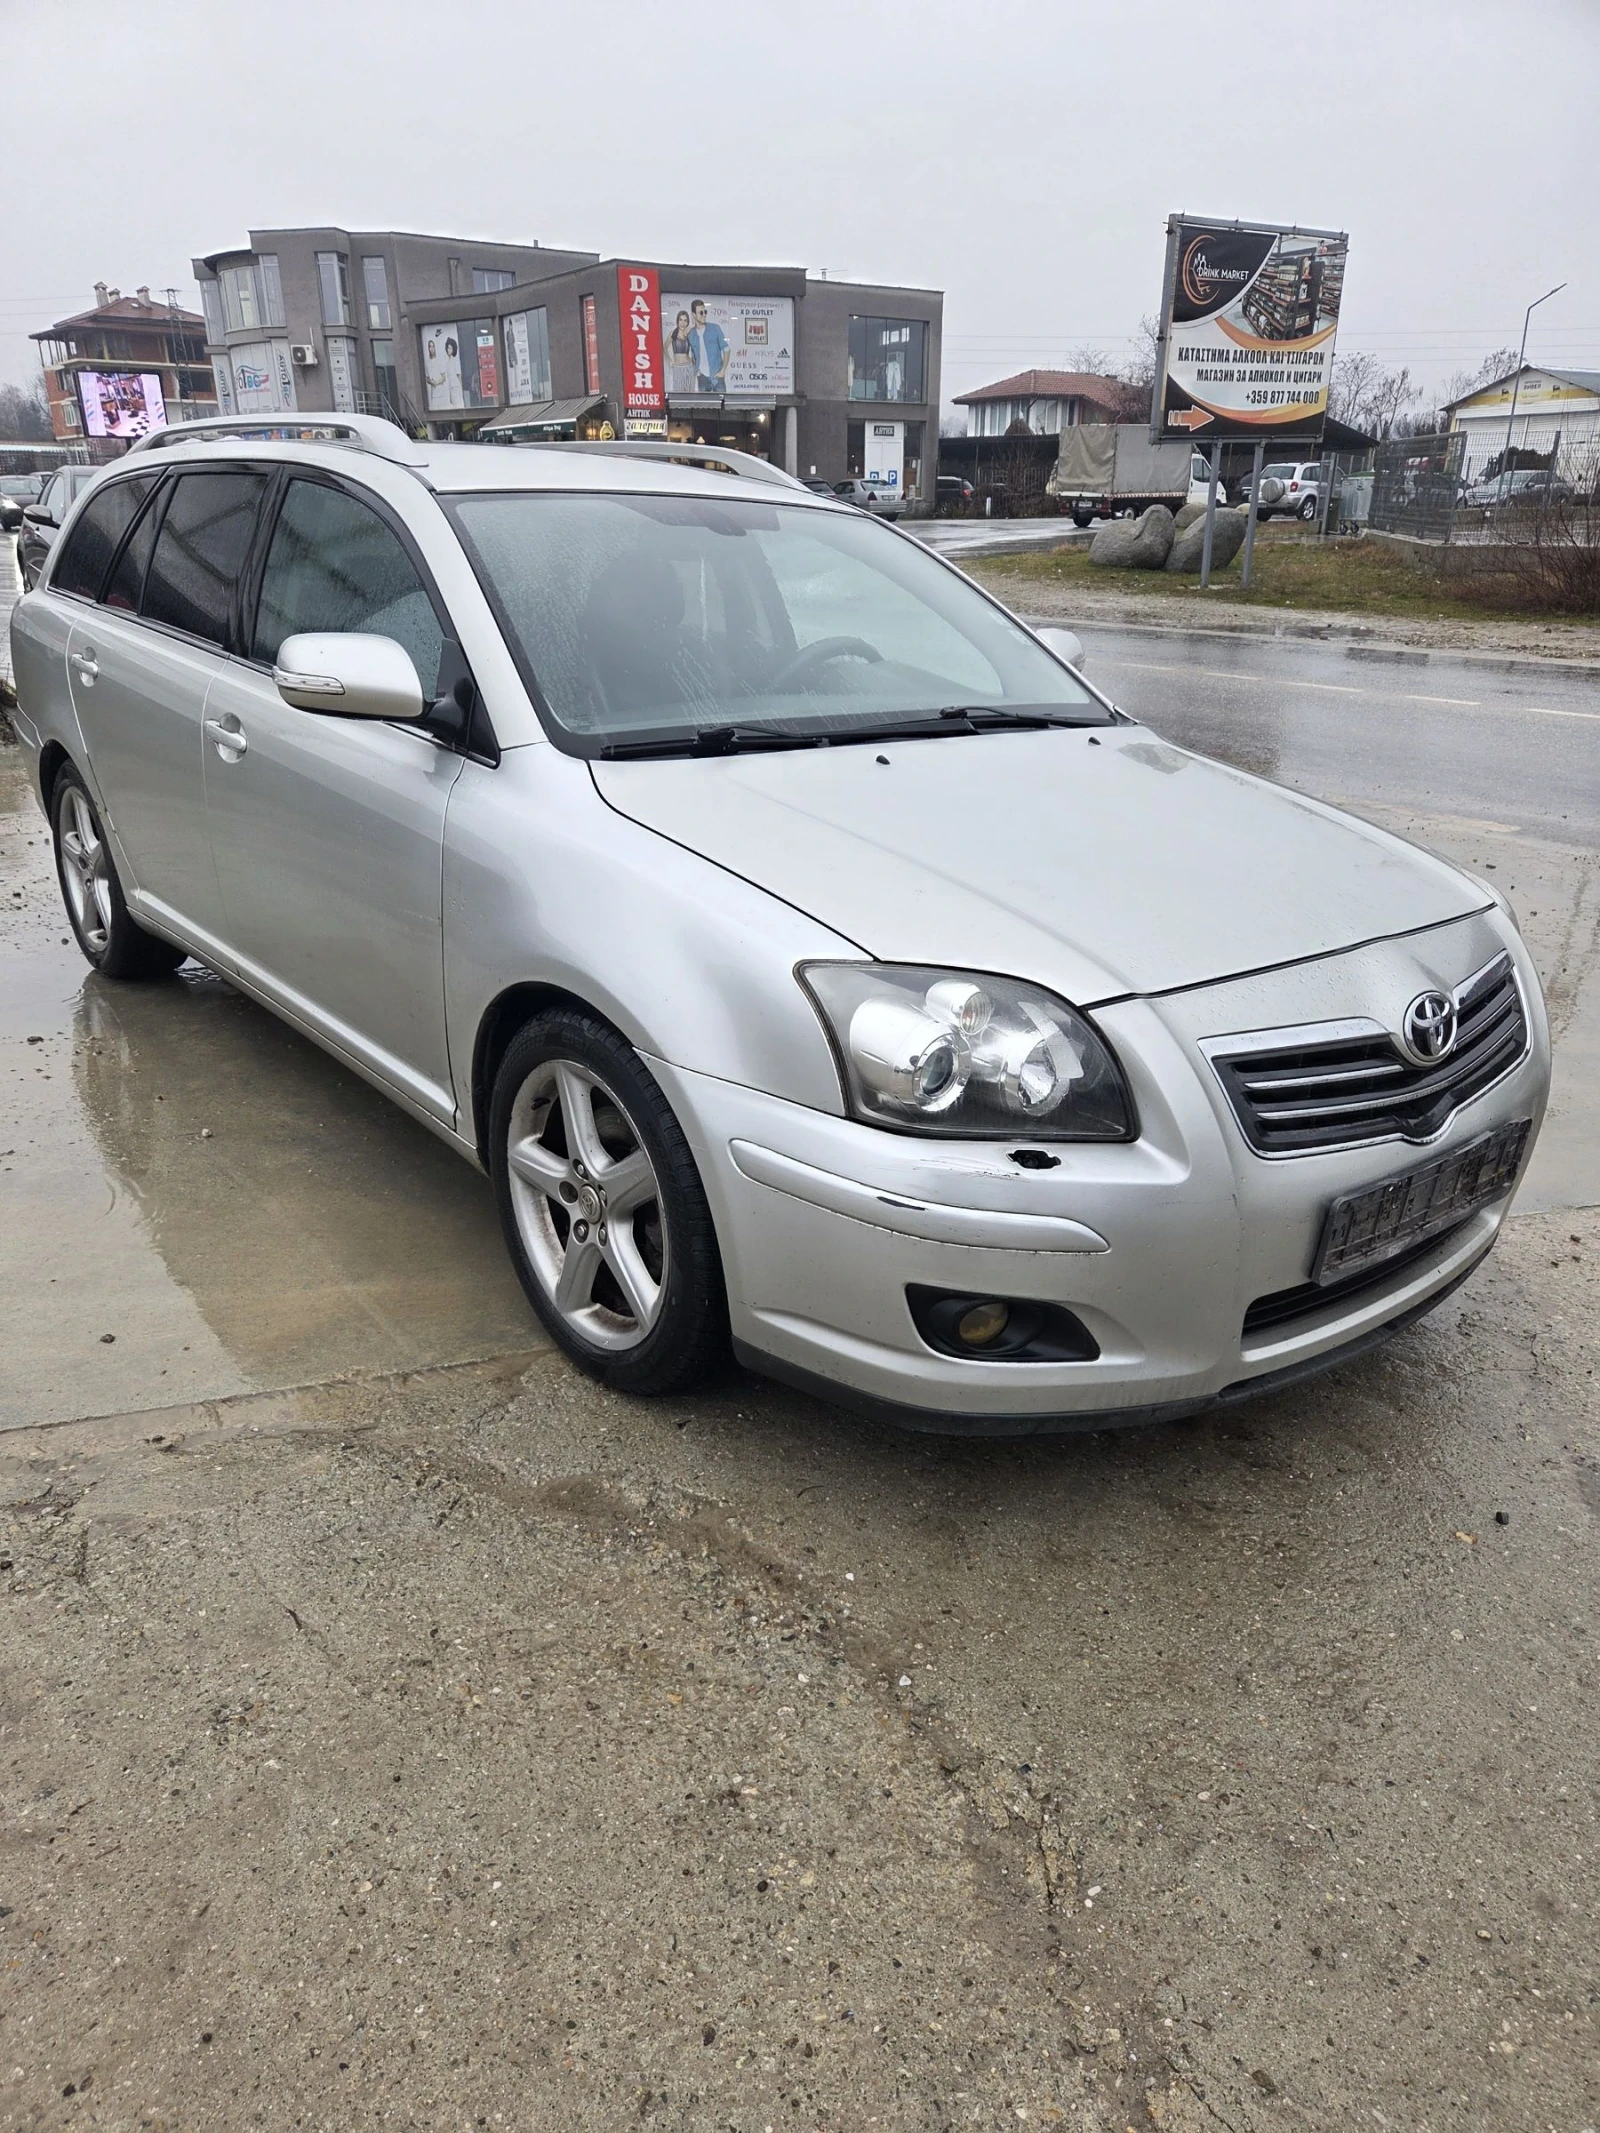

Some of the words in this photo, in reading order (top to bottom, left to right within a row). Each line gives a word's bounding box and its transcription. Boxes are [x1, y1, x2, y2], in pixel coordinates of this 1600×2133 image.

[1197, 266, 1220, 278] DRINK
[1221, 269, 1249, 280] MARKET
[629, 275, 653, 389] DANISH
[1178, 347, 1230, 363] ΚΑΤΑΣΤΗΜΑ
[1232, 349, 1267, 364] ΑΛΚΟΟΛ
[1270, 350, 1284, 364] ΚΑΙ
[1286, 350, 1325, 365] ΤΣΙΓΑΡΩΝ
[1197, 368, 1234, 382] МАГАЗИН
[1236, 369, 1246, 382] ЗА
[1248, 369, 1285, 383] АЛКОХОЛ
[1286, 370, 1292, 383] И
[1293, 371, 1322, 384] ЦИГАРИ
[628, 393, 660, 406] HOUSE
[1245, 390, 1269, 404] +359
[1270, 390, 1285, 404] 877
[1286, 390, 1302, 404] 744
[1303, 390, 1320, 404] 000
[627, 409, 651, 418] АНТИК
[626, 421, 665, 433] галерия
